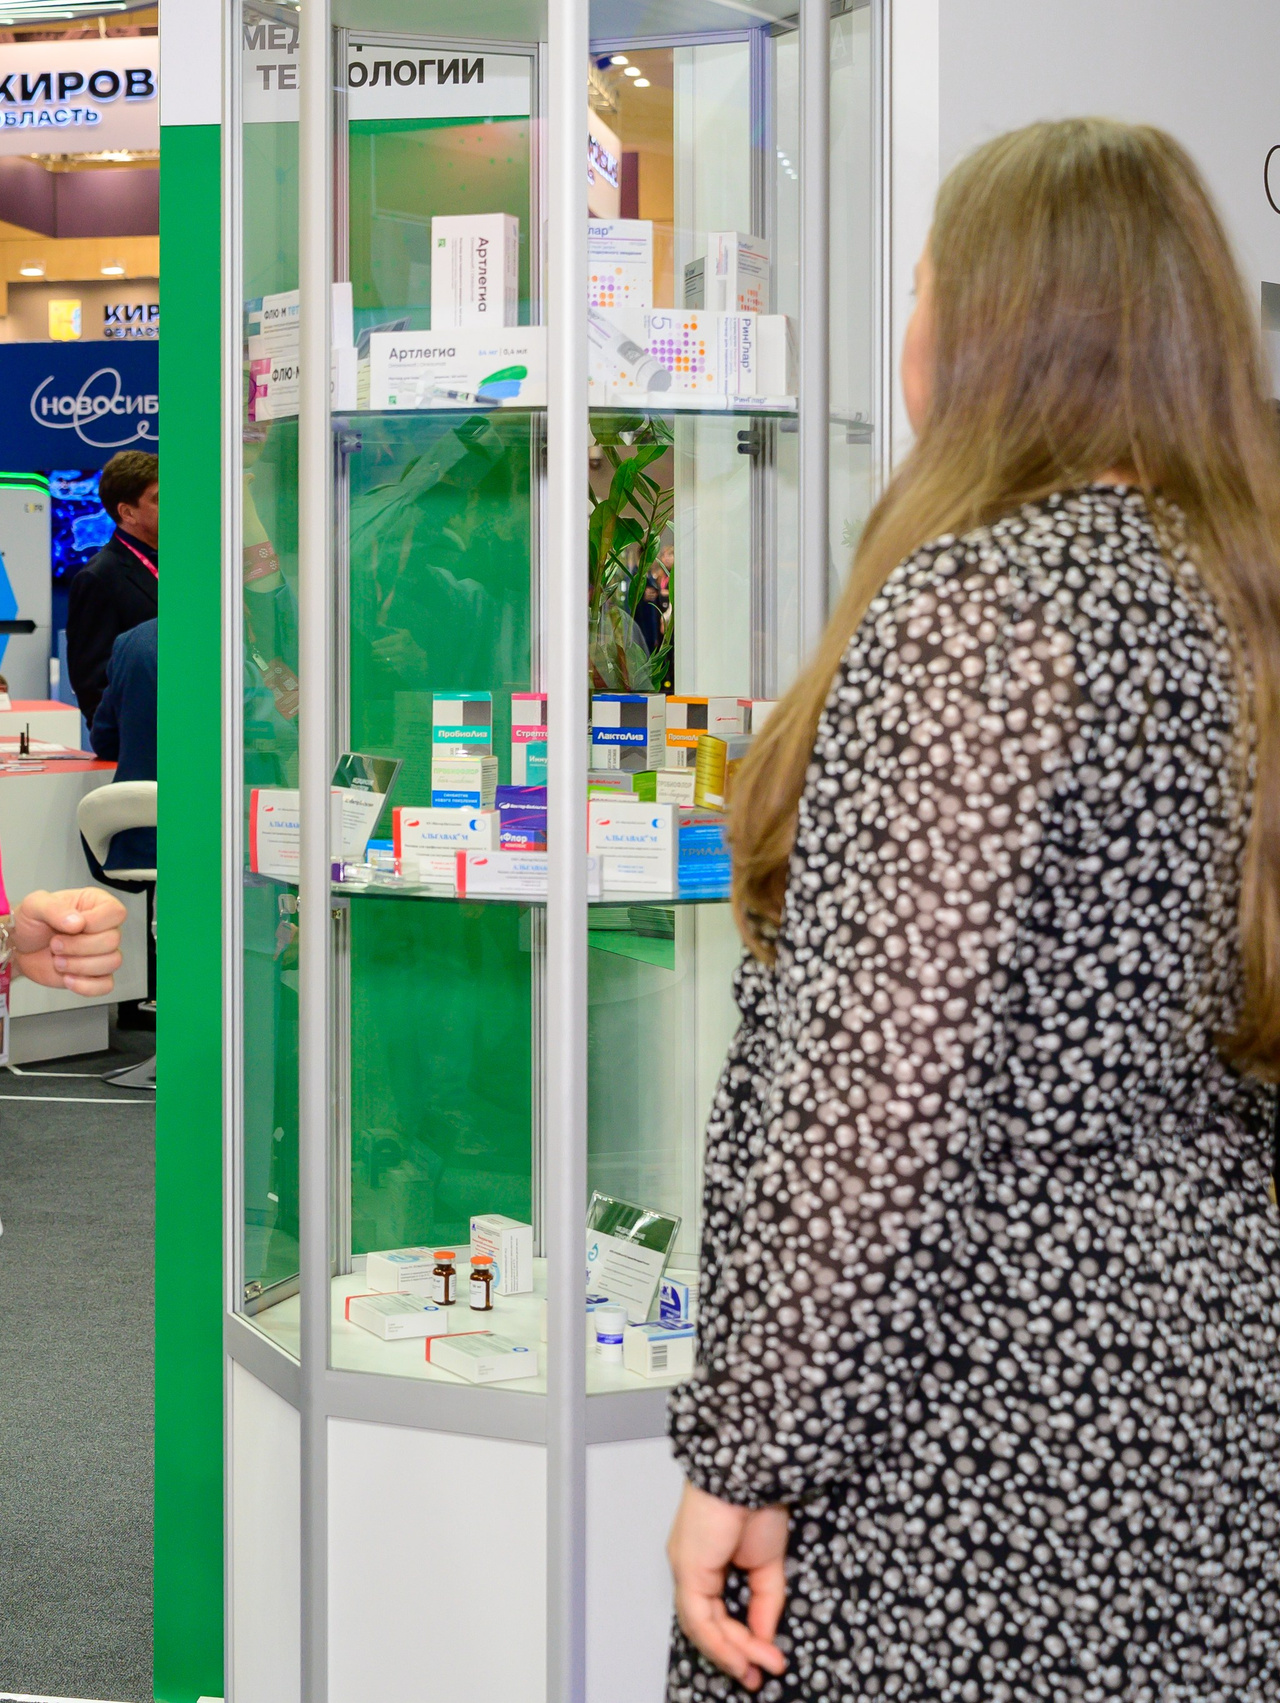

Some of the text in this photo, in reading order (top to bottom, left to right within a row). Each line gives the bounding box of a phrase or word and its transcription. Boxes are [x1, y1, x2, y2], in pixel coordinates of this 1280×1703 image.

[256, 58, 484, 90] ТЕОЛОГИИ
[476, 237, 489, 313] Артлегиа
[389, 347, 456, 362] Артлегиа
[438, 730, 488, 739] ПробиоЛиз
[597, 732, 644, 741] ЛактоЛиз
